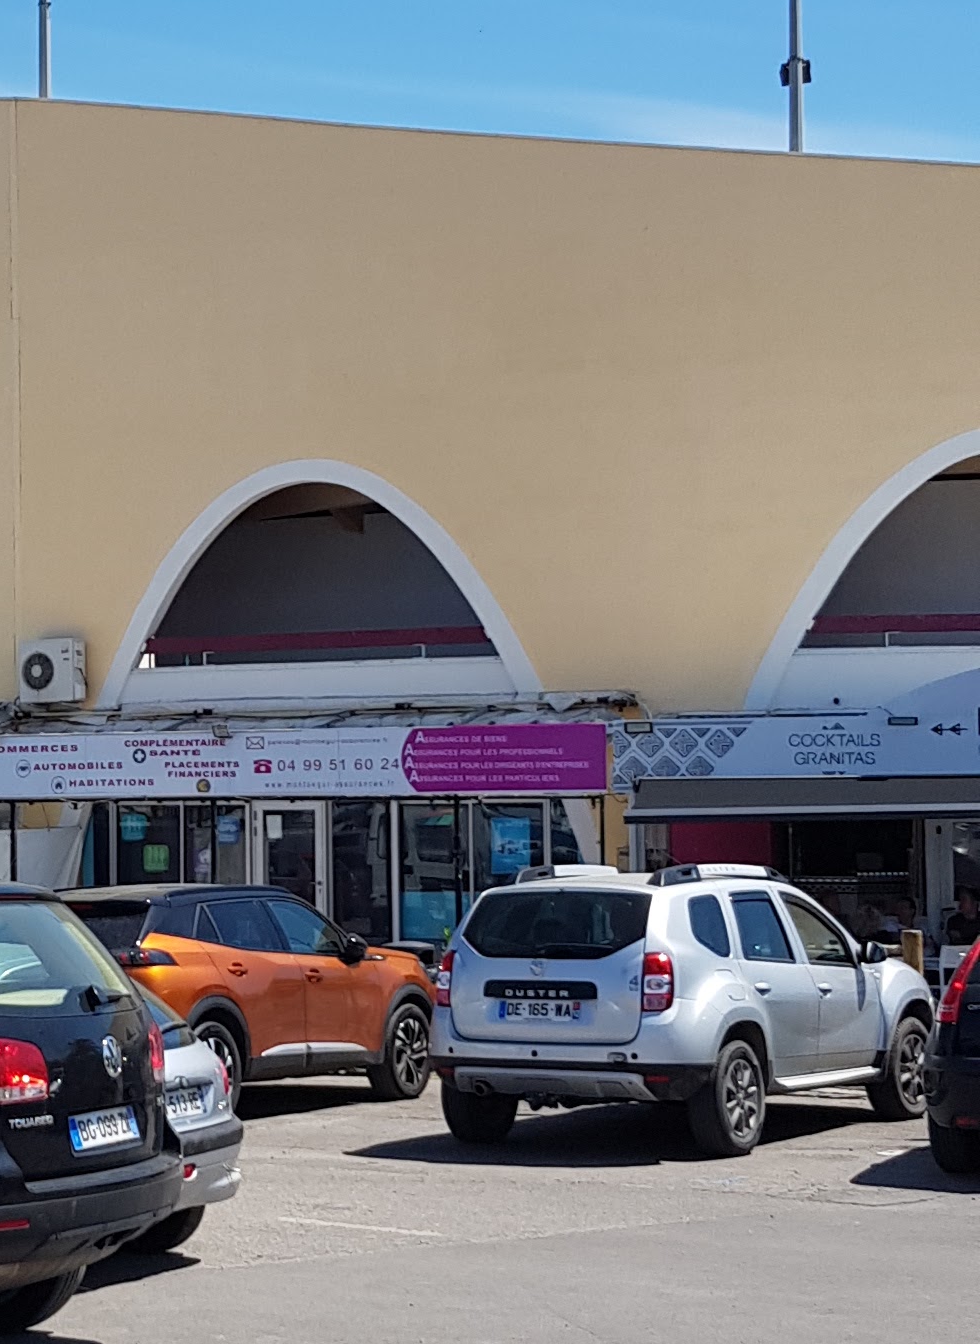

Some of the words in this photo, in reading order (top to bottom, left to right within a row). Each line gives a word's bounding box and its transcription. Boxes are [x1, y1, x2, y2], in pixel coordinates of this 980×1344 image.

[788, 733, 881, 748] COCKTAILS
[149, 749, 201, 757] SANTÉ
[793, 751, 876, 765] GRANITAS
[33, 761, 124, 771] AUTOMOBILES
[164, 760, 240, 769] PLACEMENTS
[277, 759, 296, 772] 04
[303, 759, 322, 771] 99
[329, 758, 347, 771] 51
[354, 758, 374, 771] 60
[380, 757, 400, 770] 24
[167, 769, 237, 778] FINANCIERS
[69, 778, 155, 788] HABITATIONS
[504, 988, 570, 997] DUSTER
